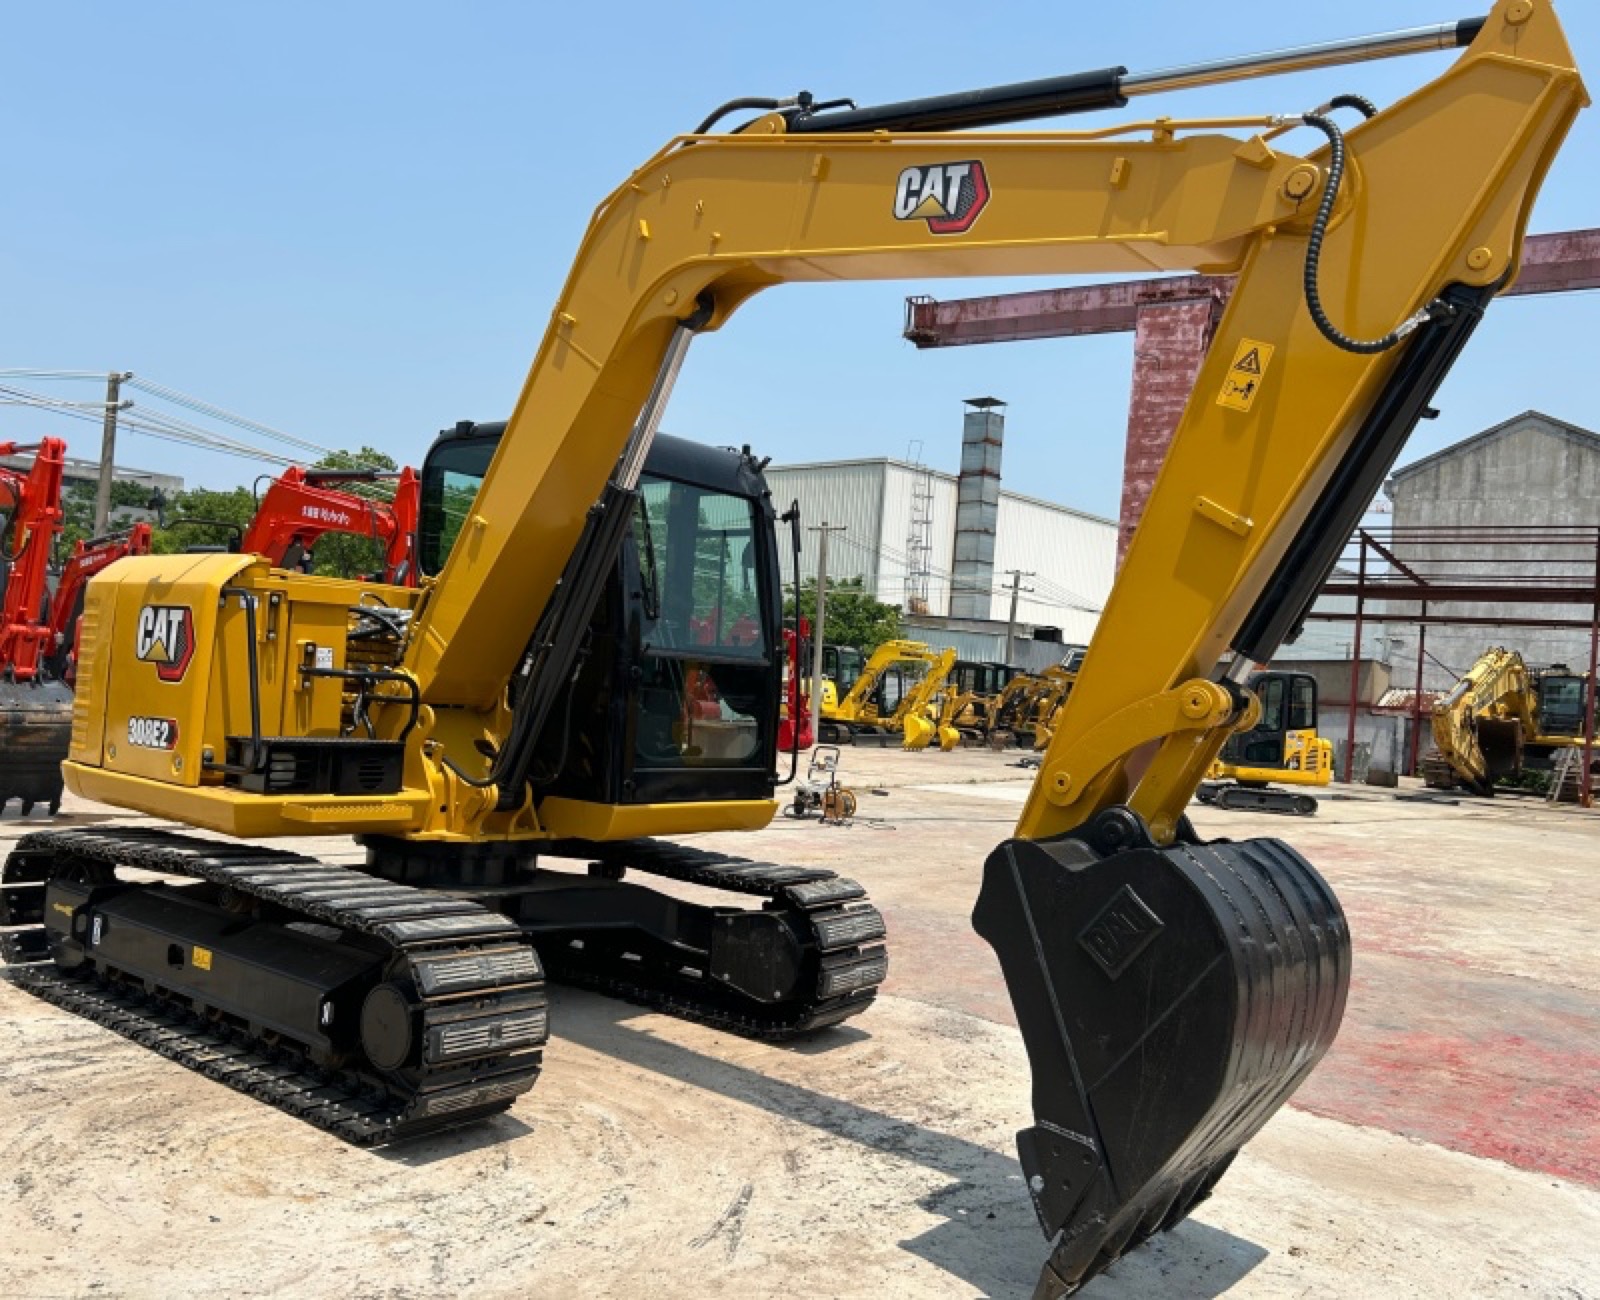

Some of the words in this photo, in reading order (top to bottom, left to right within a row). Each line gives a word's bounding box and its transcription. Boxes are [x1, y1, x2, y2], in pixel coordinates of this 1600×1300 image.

[895, 164, 969, 219] CAT
[137, 606, 185, 662] CAT
[128, 717, 169, 747] 308E2
